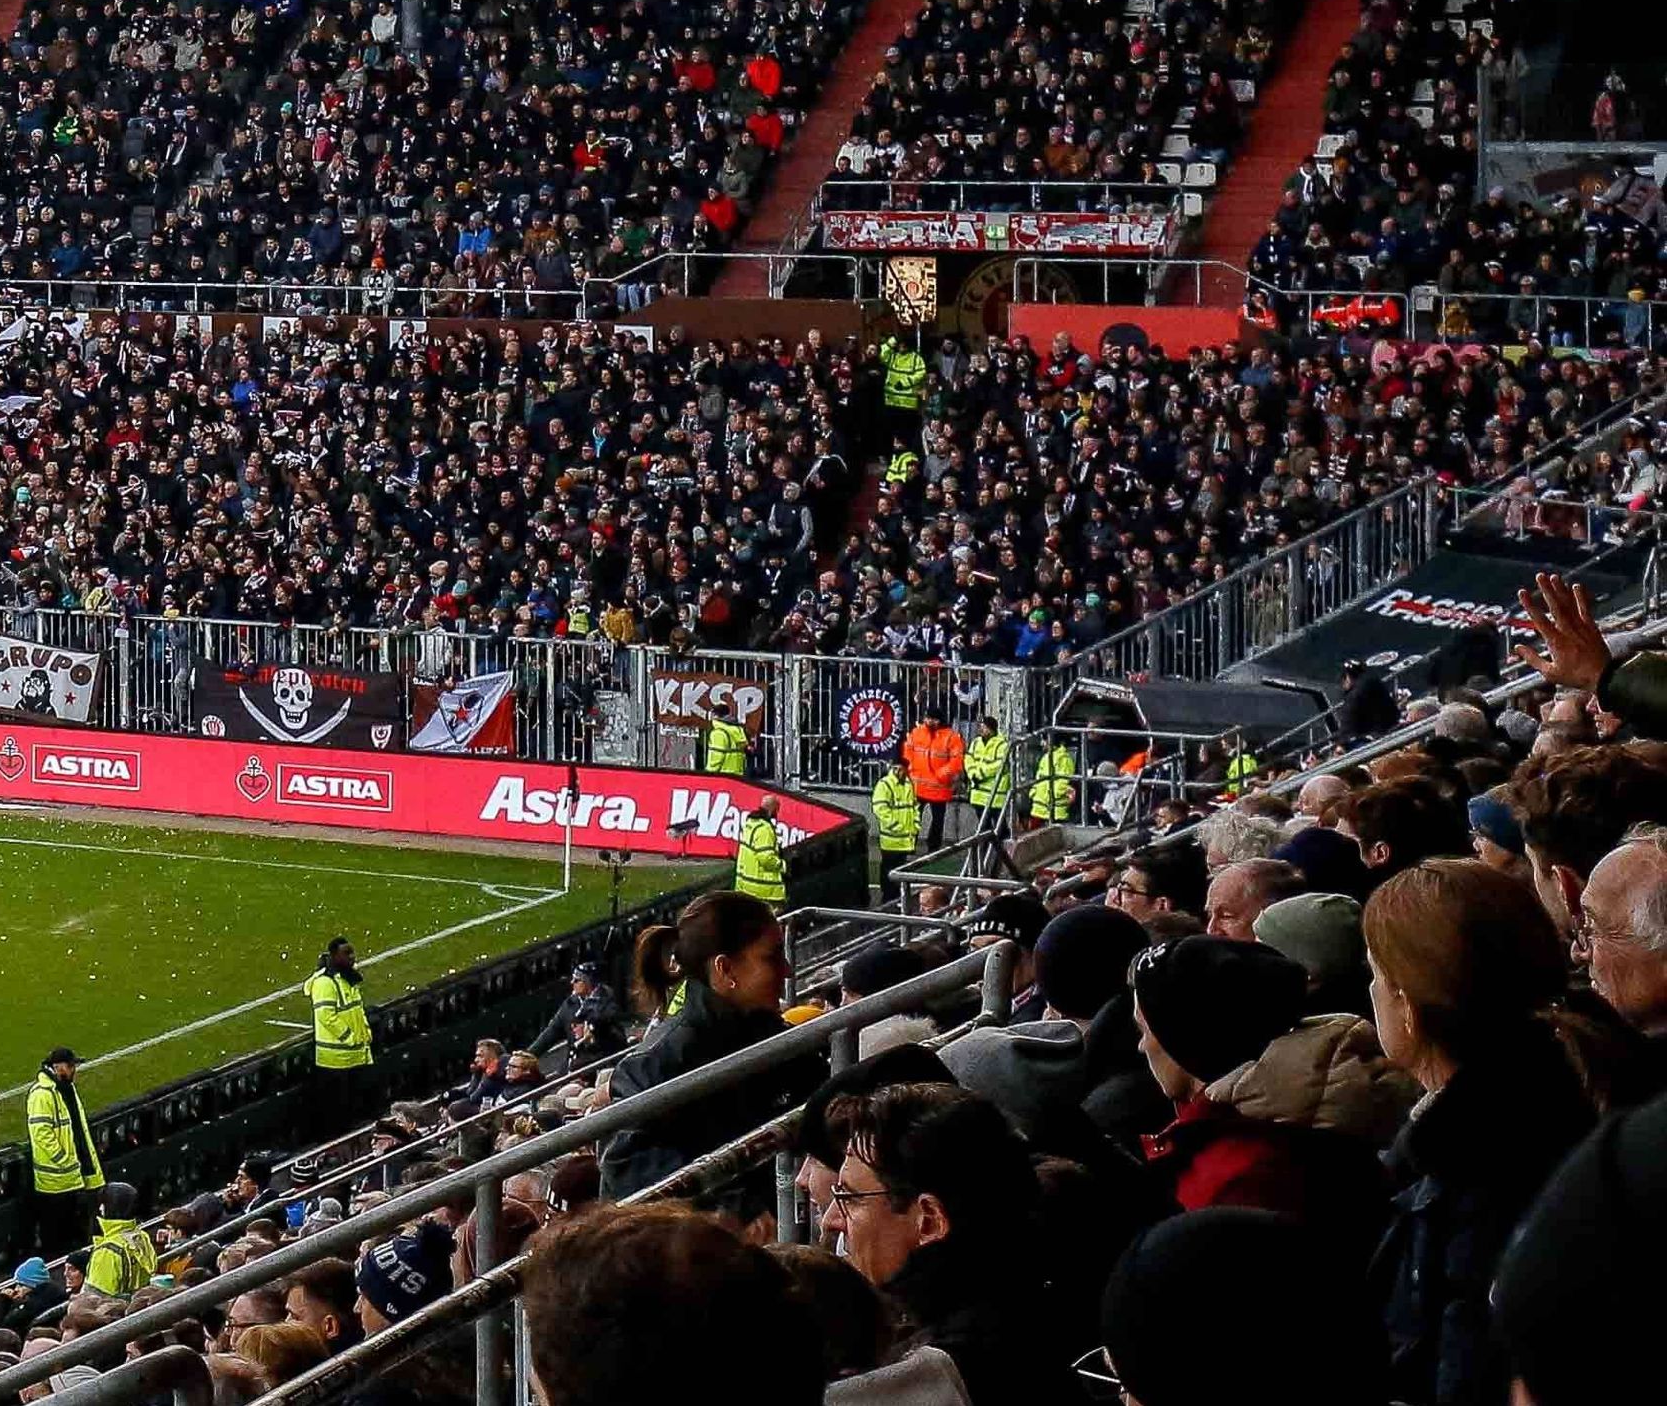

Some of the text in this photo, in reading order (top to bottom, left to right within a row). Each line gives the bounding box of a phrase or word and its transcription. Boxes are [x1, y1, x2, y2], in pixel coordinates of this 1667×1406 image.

[40, 756, 132, 781] ASTRA
[286, 775, 384, 802] ASTRA
[480, 775, 652, 831] Astra.
[669, 787, 746, 839] Wa
